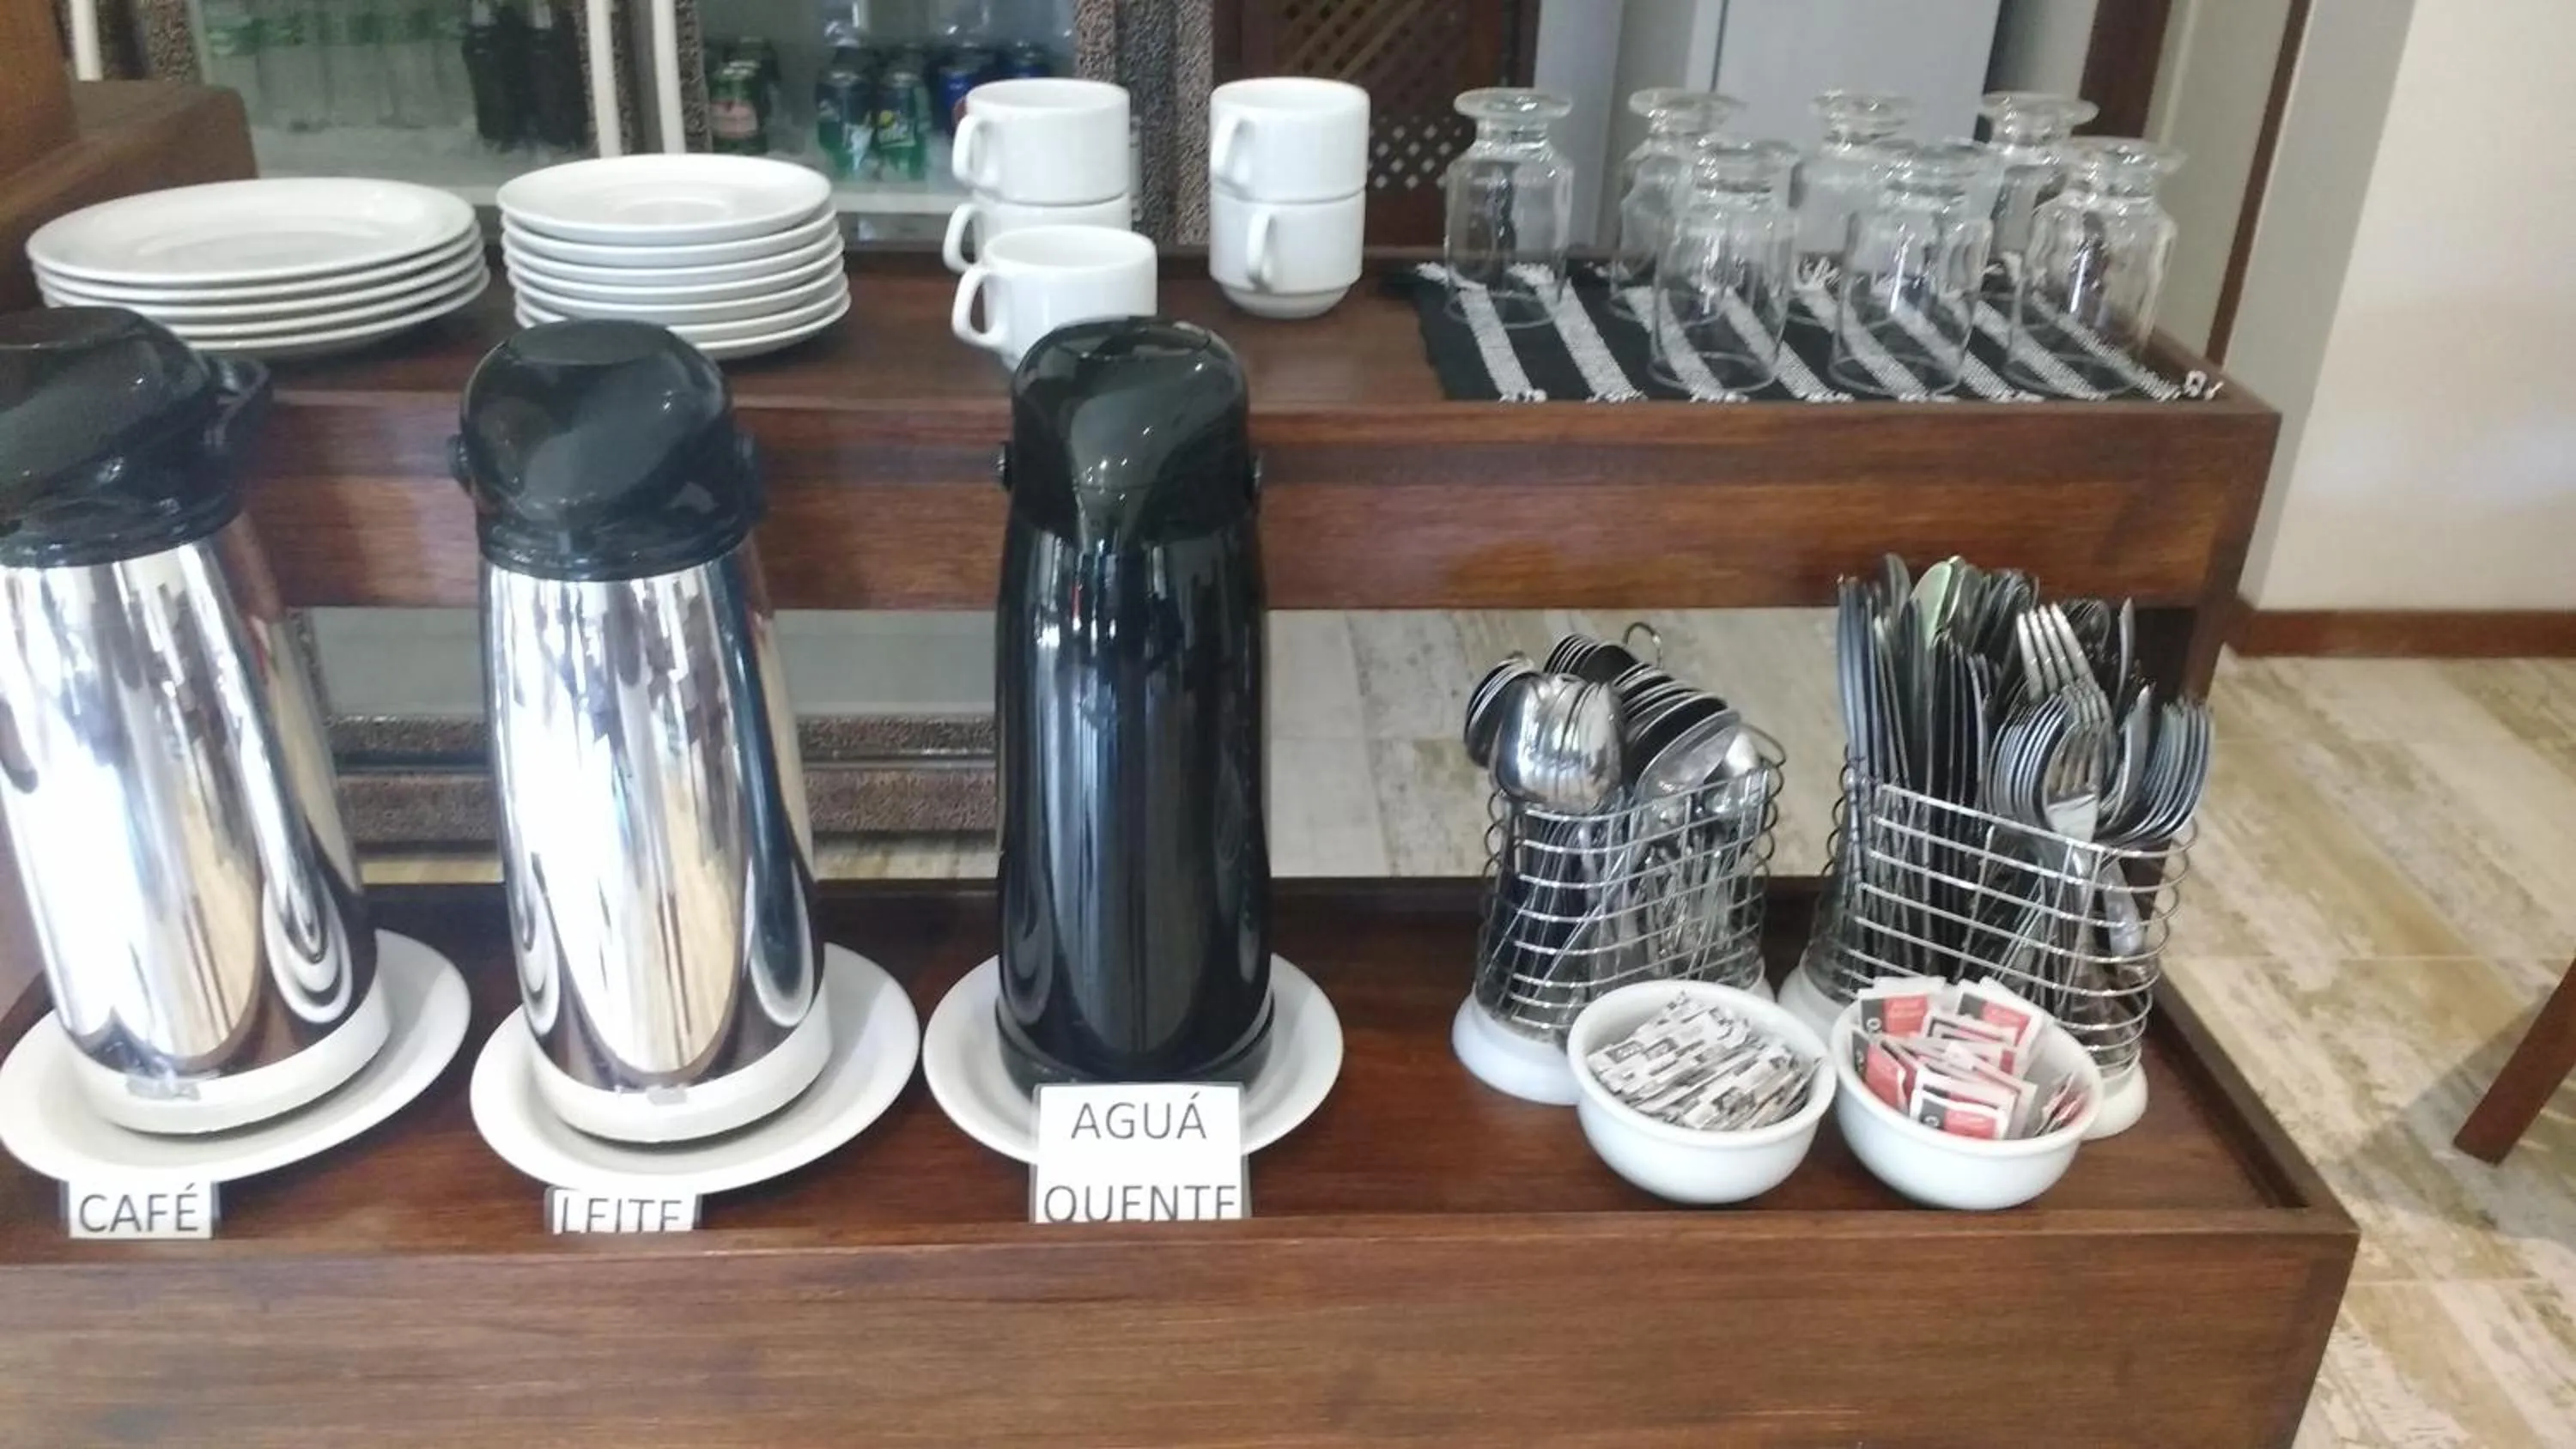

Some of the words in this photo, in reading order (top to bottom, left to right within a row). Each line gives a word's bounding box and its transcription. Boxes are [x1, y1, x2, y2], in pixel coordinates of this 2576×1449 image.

[1071, 1091, 1207, 1140] AGUÁ
[79, 1182, 199, 1233] CAFÉ
[562, 1197, 683, 1234] LEITE
[1043, 1185, 1237, 1222] QUENTE
